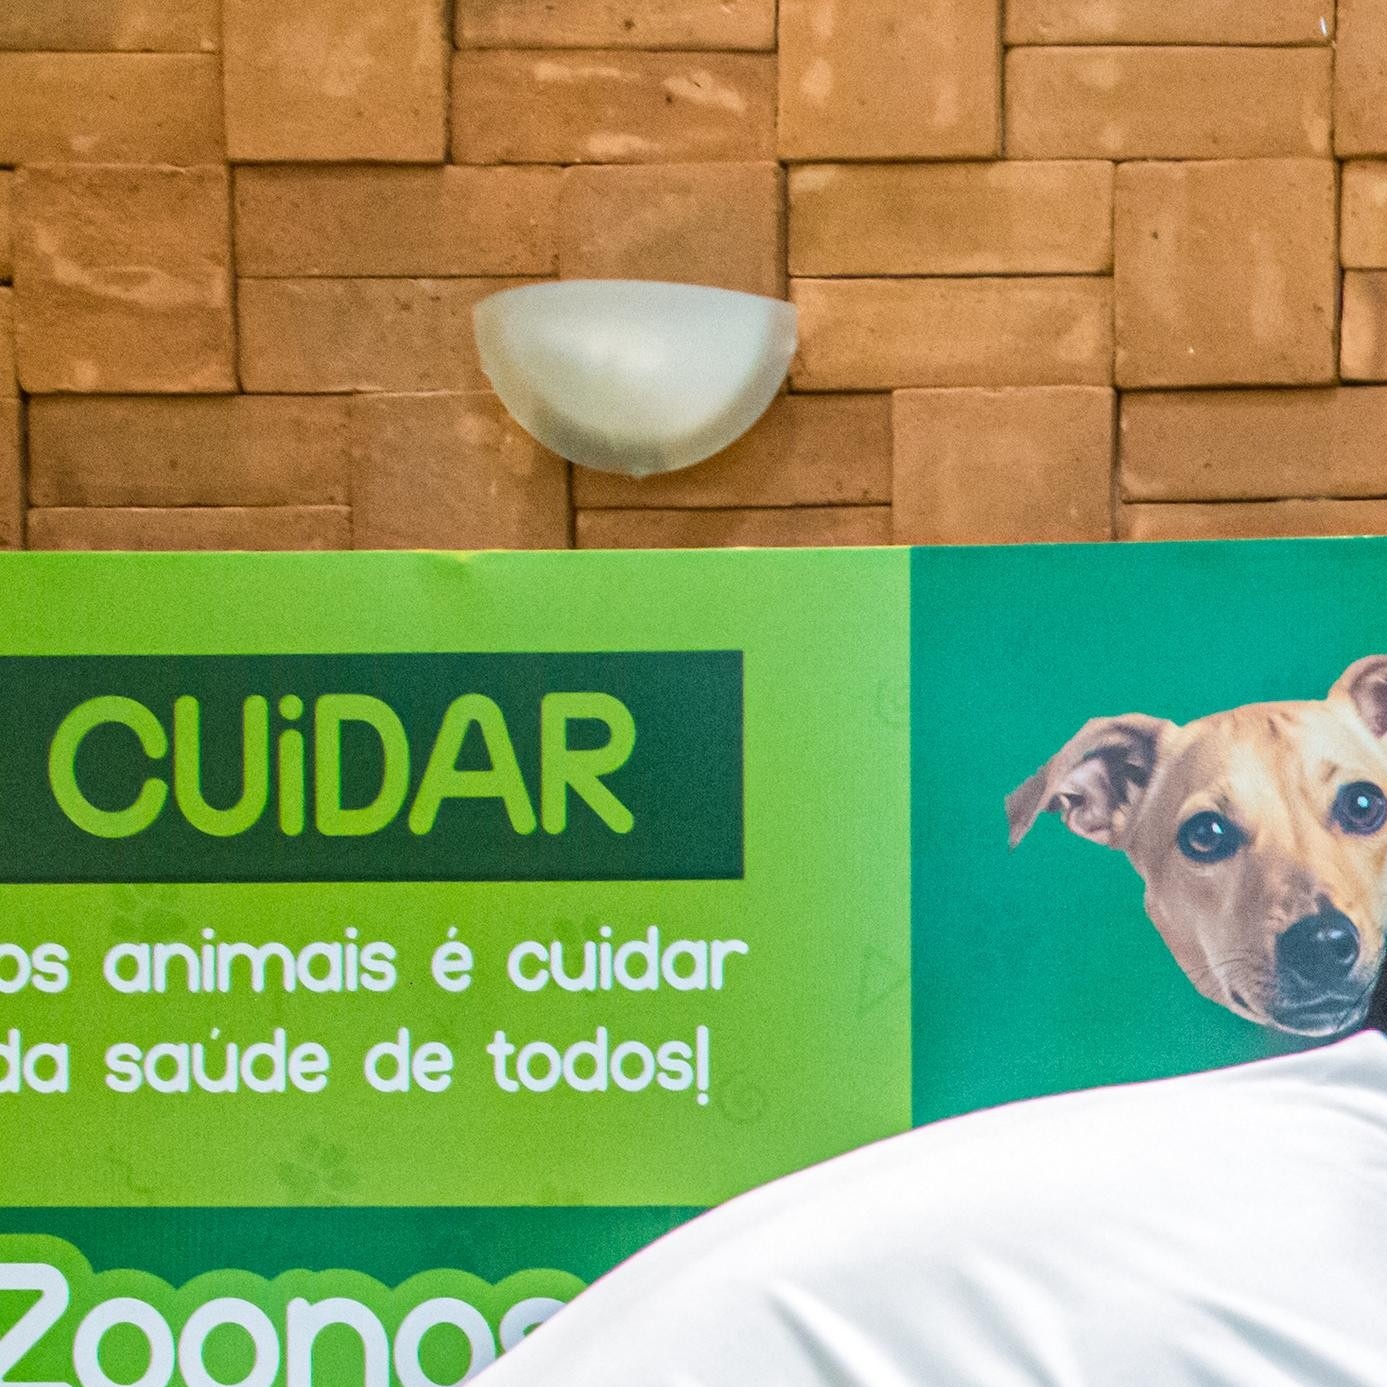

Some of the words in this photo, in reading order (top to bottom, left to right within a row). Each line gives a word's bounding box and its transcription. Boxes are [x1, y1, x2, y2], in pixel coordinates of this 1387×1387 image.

[104, 925, 397, 994] animais
[431, 926, 474, 993] é
[507, 925, 750, 993] cuidar
[105, 1027, 331, 1094] saúde
[364, 1027, 455, 1094] de
[486, 1025, 712, 1107] todos!
